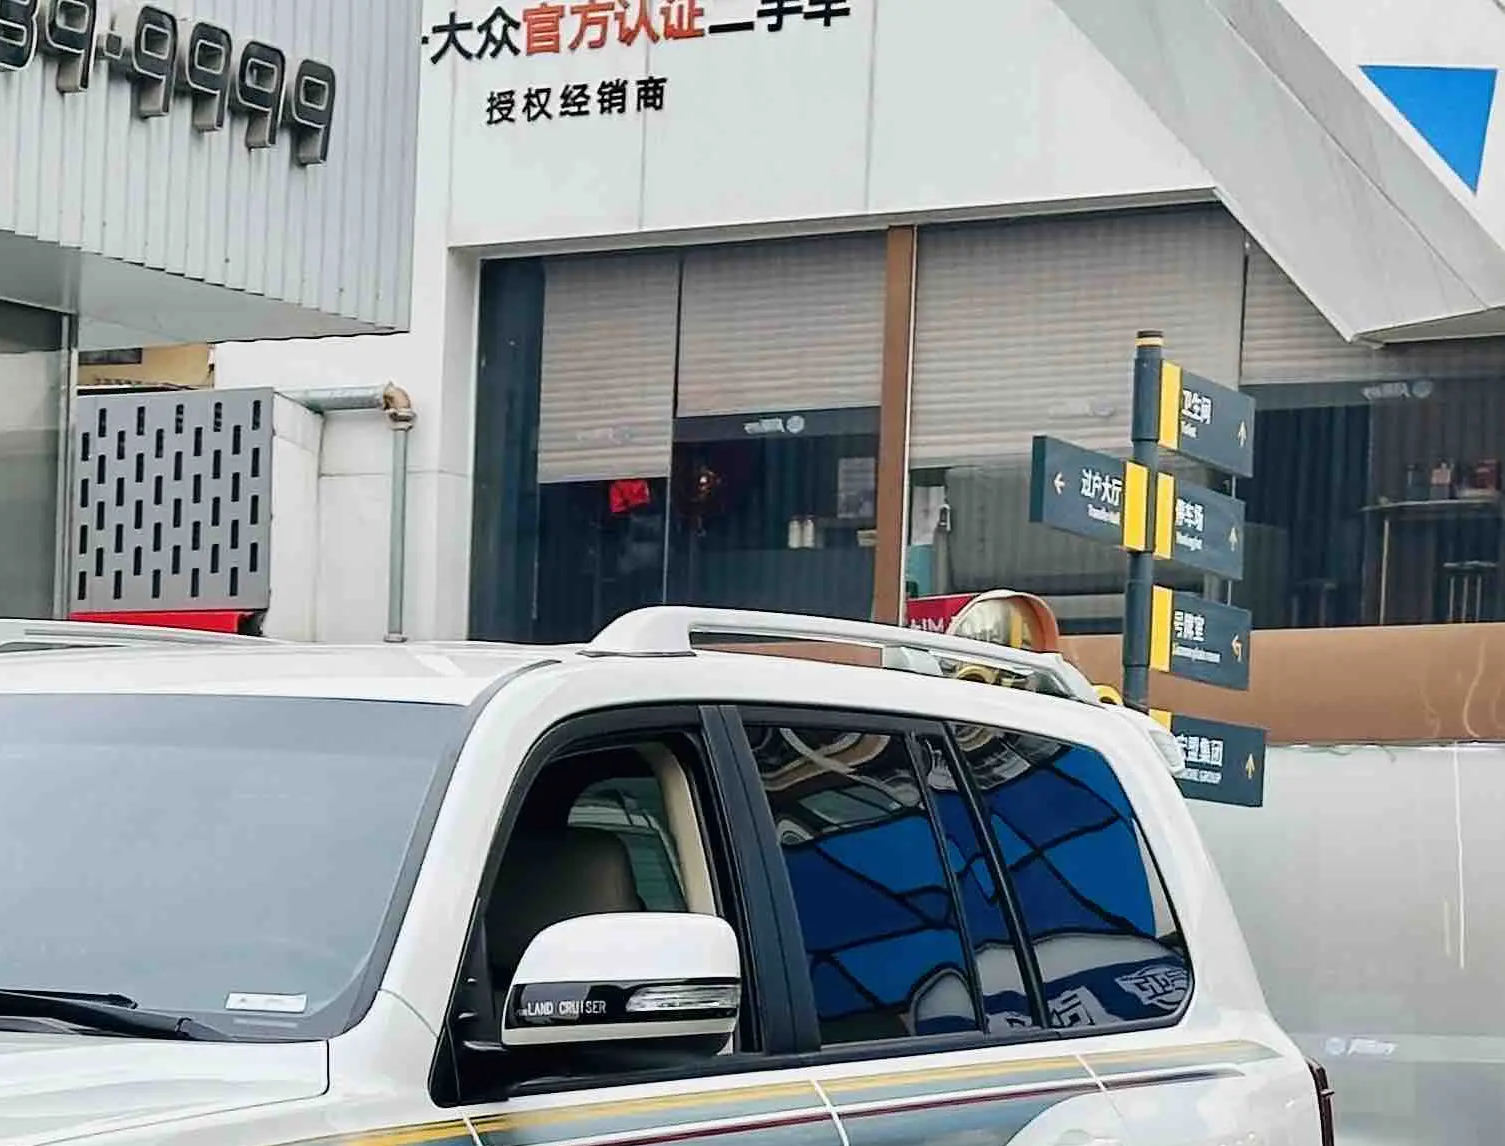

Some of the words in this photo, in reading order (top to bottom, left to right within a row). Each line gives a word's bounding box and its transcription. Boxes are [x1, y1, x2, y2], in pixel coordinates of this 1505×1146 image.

[486, 76, 668, 126] 授权经销商
[1080, 468, 1122, 506] 过户大厅
[527, 1001, 555, 1017] LAND
[558, 1000, 607, 1015] CRUISER
